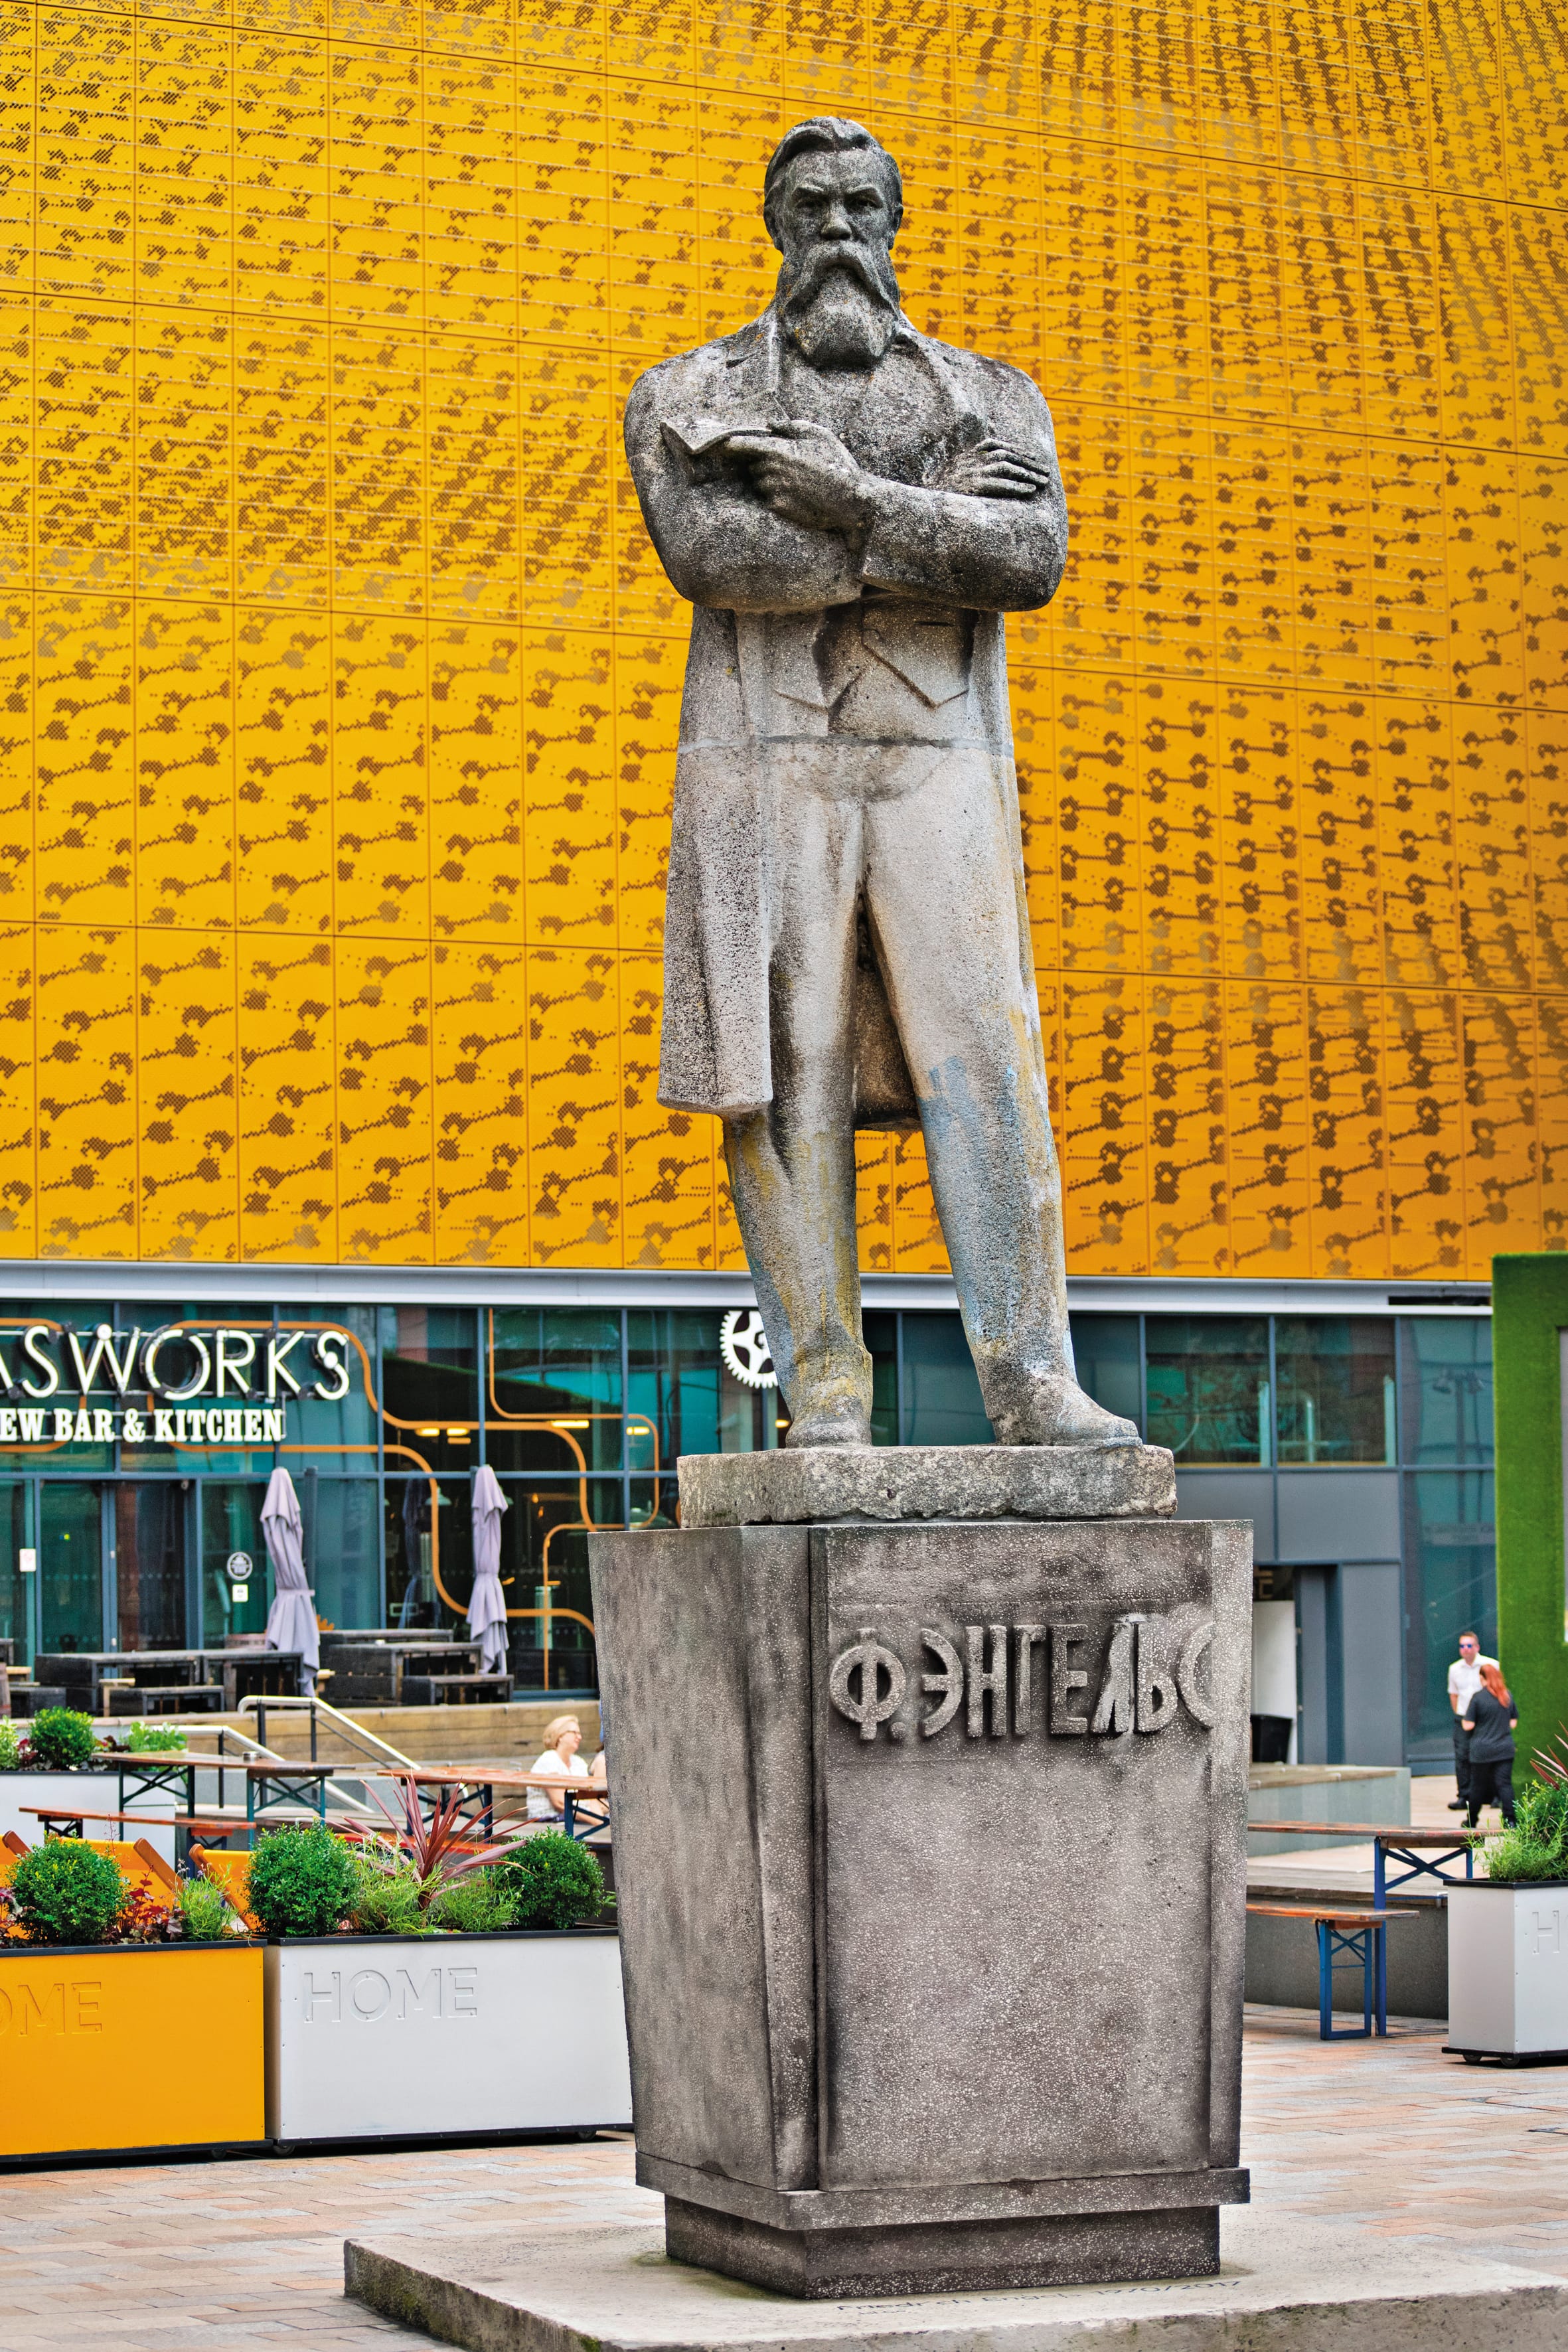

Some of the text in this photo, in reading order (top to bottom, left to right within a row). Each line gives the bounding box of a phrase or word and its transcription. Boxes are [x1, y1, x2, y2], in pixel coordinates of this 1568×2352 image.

[54, 1408, 115, 1442] BAR
[123, 1408, 145, 1443] &
[153, 1409, 283, 1442] KITCHEN
[830, 1621, 1214, 1740] Ф. ЭНГЕЛЬС
[0, 1981, 102, 2037] ME
[303, 1966, 478, 2023] HOME
[836, 2299, 971, 2311] Friedrch
